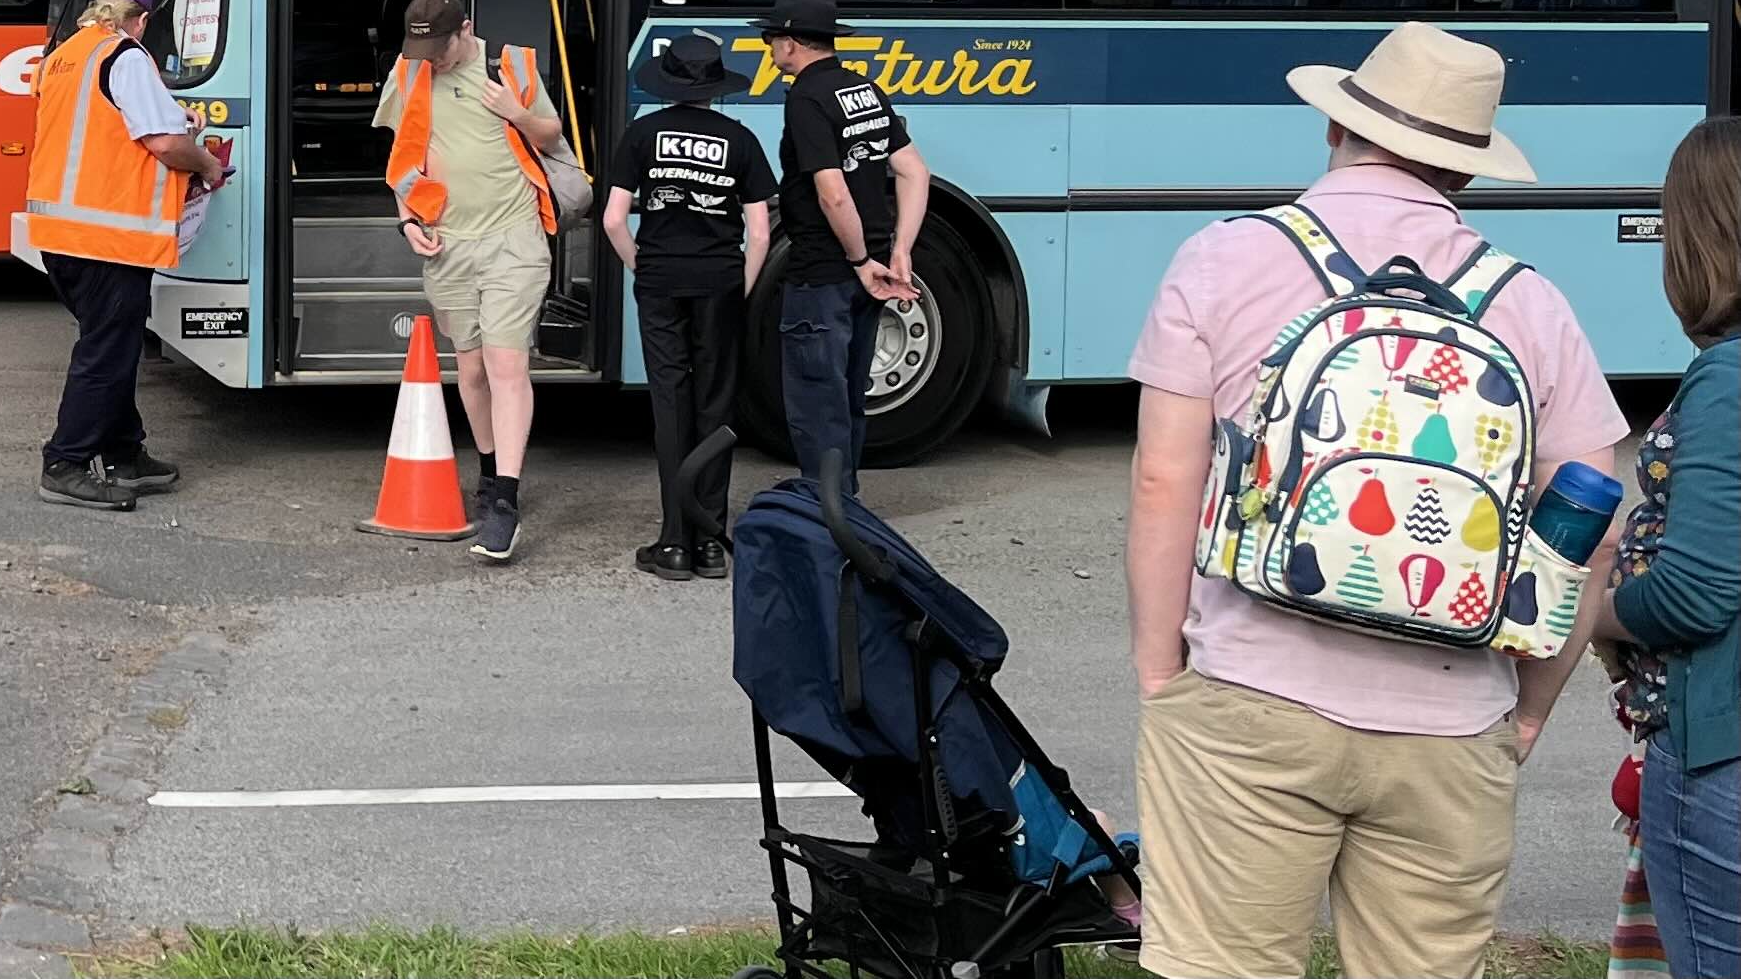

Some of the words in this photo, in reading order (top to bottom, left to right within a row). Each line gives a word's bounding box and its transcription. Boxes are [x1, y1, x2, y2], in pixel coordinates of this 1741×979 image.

[191, 33, 207, 44] BUS
[973, 39, 1004, 51] Since
[1006, 39, 1032, 51] 1924
[842, 89, 878, 113] K160
[662, 137, 723, 162] K160
[648, 167, 736, 187] OVERHAULED
[1636, 226, 1656, 234] EXIT
[185, 312, 243, 322] EMERGENCY
[203, 321, 226, 330] EXIT
